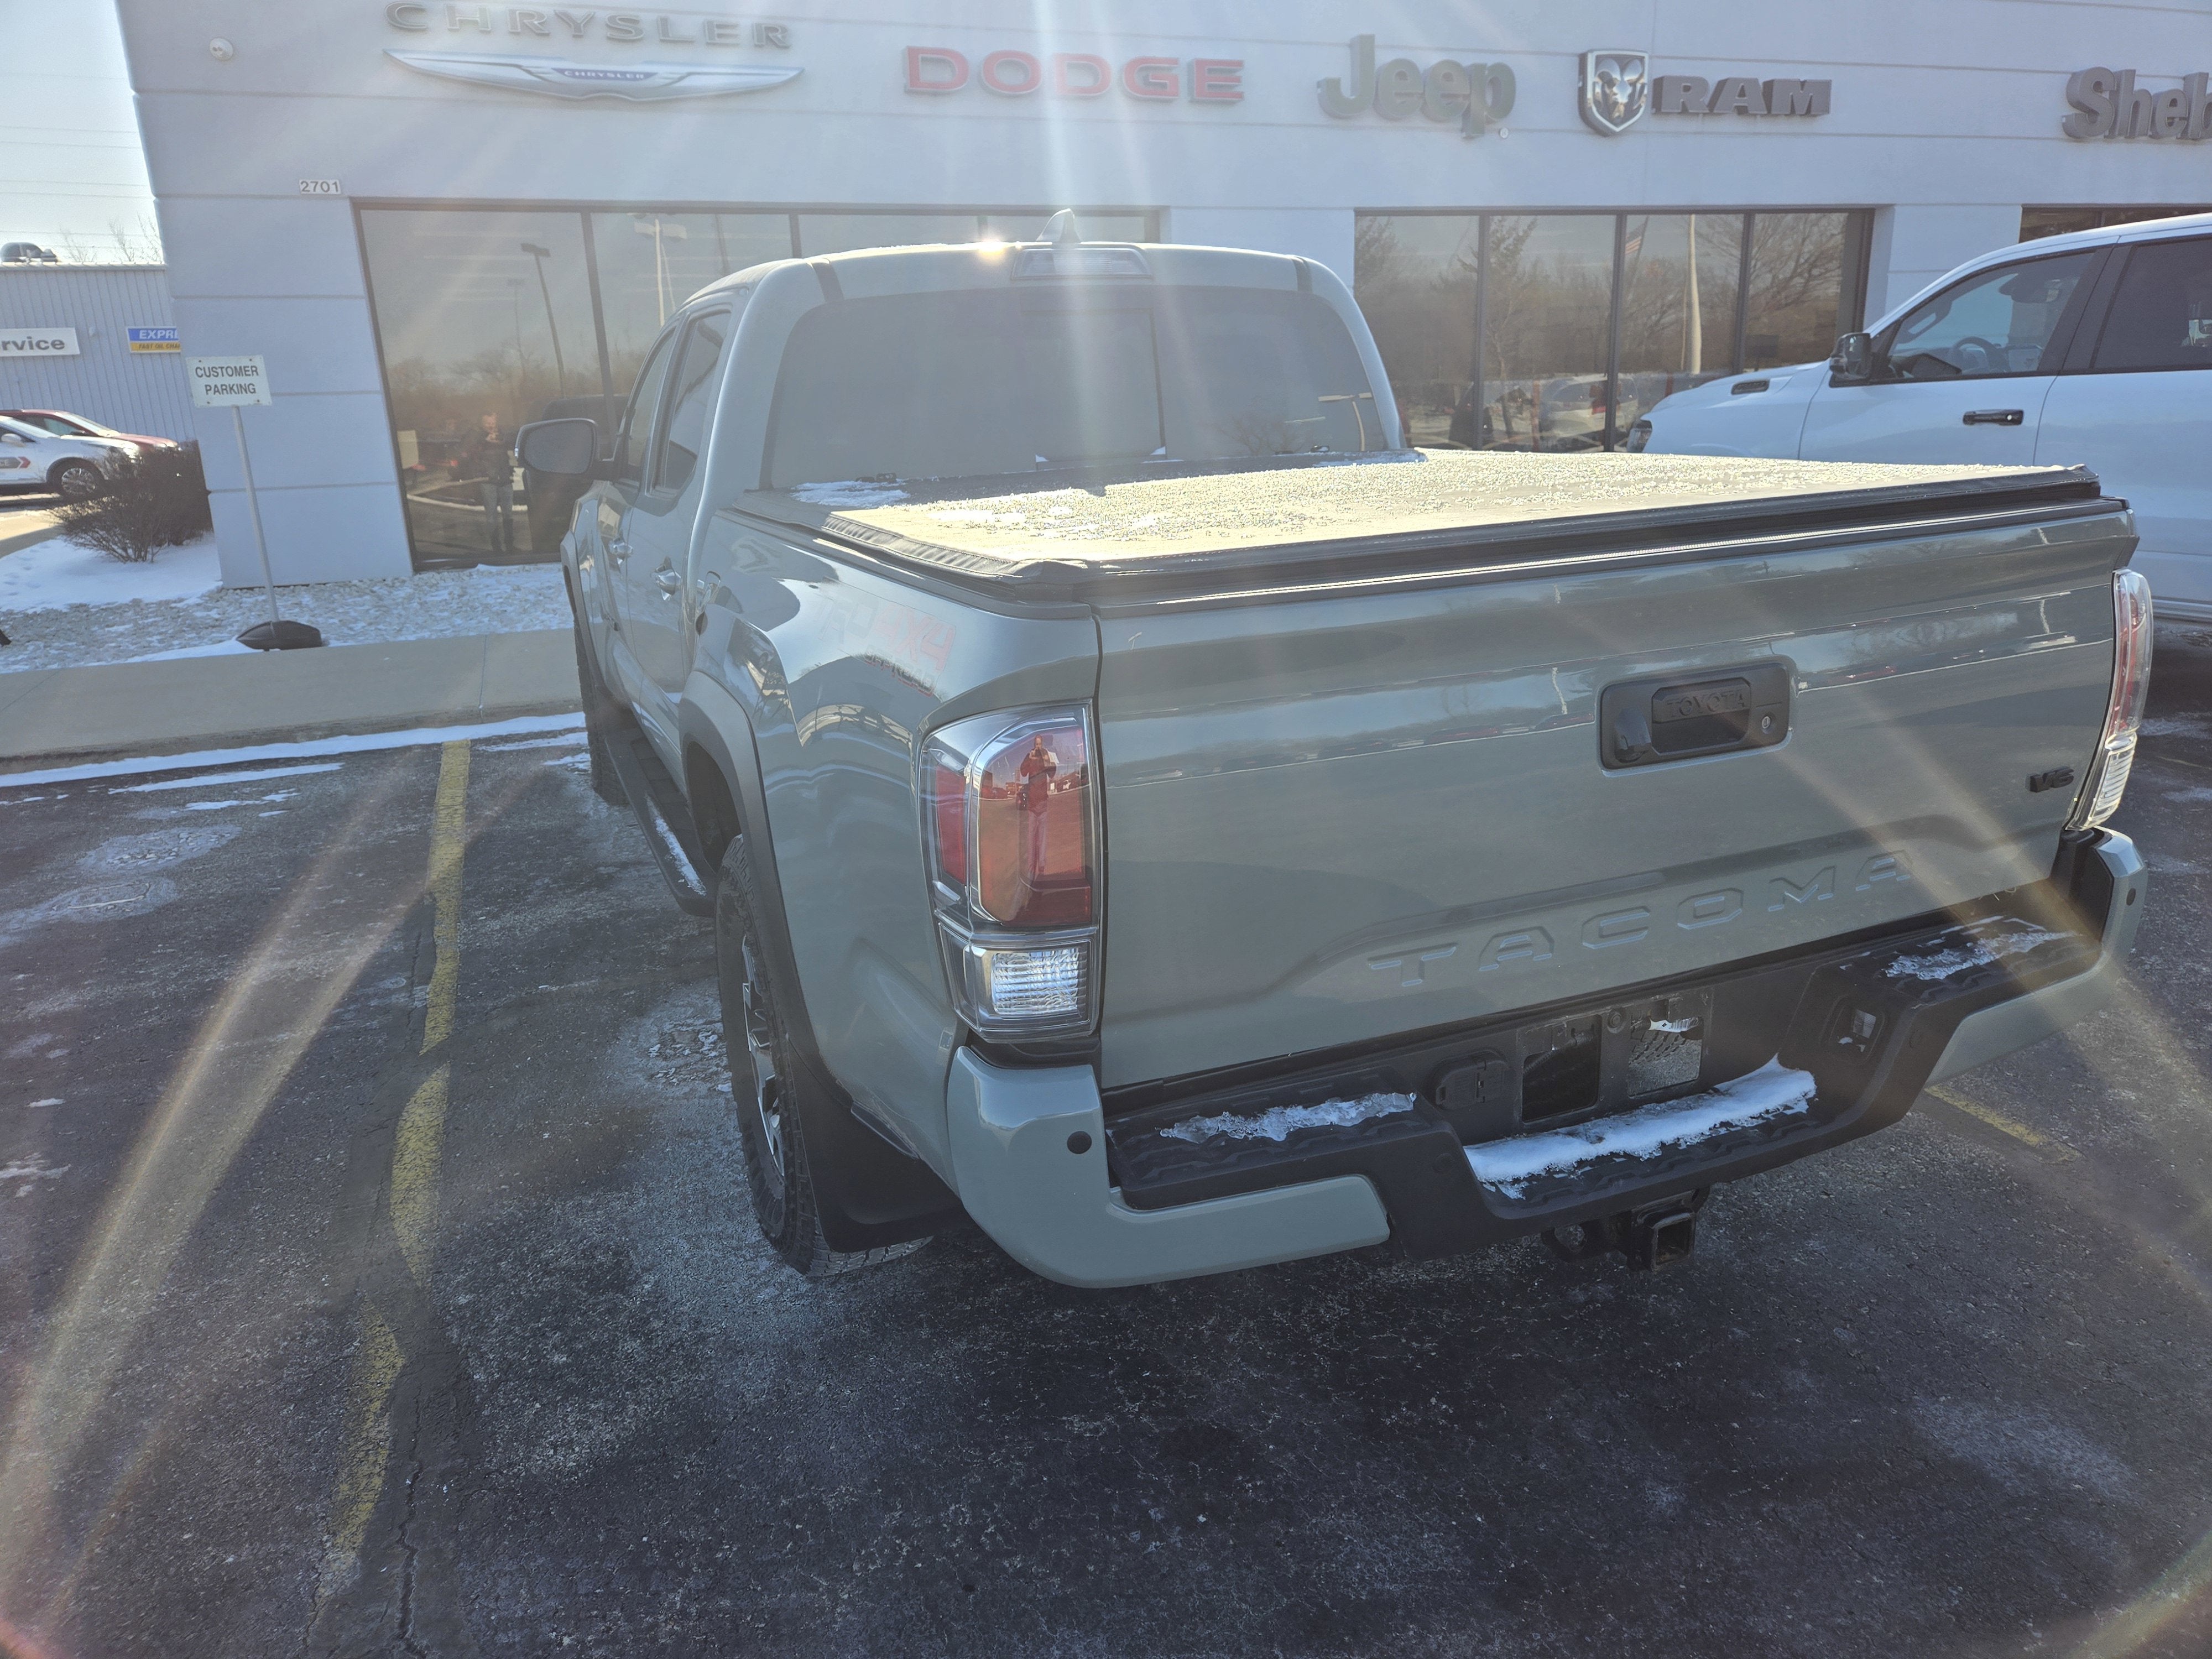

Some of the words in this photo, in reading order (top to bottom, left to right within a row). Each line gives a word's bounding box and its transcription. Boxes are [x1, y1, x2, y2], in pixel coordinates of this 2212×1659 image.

[383, 1, 791, 49] CHRYSLER
[905, 45, 1245, 101] DODGE
[1317, 34, 1516, 139] Jeep
[1652, 75, 1833, 115] RAM
[300, 180, 338, 192] 2701
[2, 336, 65, 351] rvice
[195, 366, 259, 378] CUSTOMER
[205, 383, 256, 395] PARKING
[1666, 687, 1745, 719] TOYOTA
[2027, 767, 2074, 793] V6
[1367, 849, 1912, 987] TACOMA
